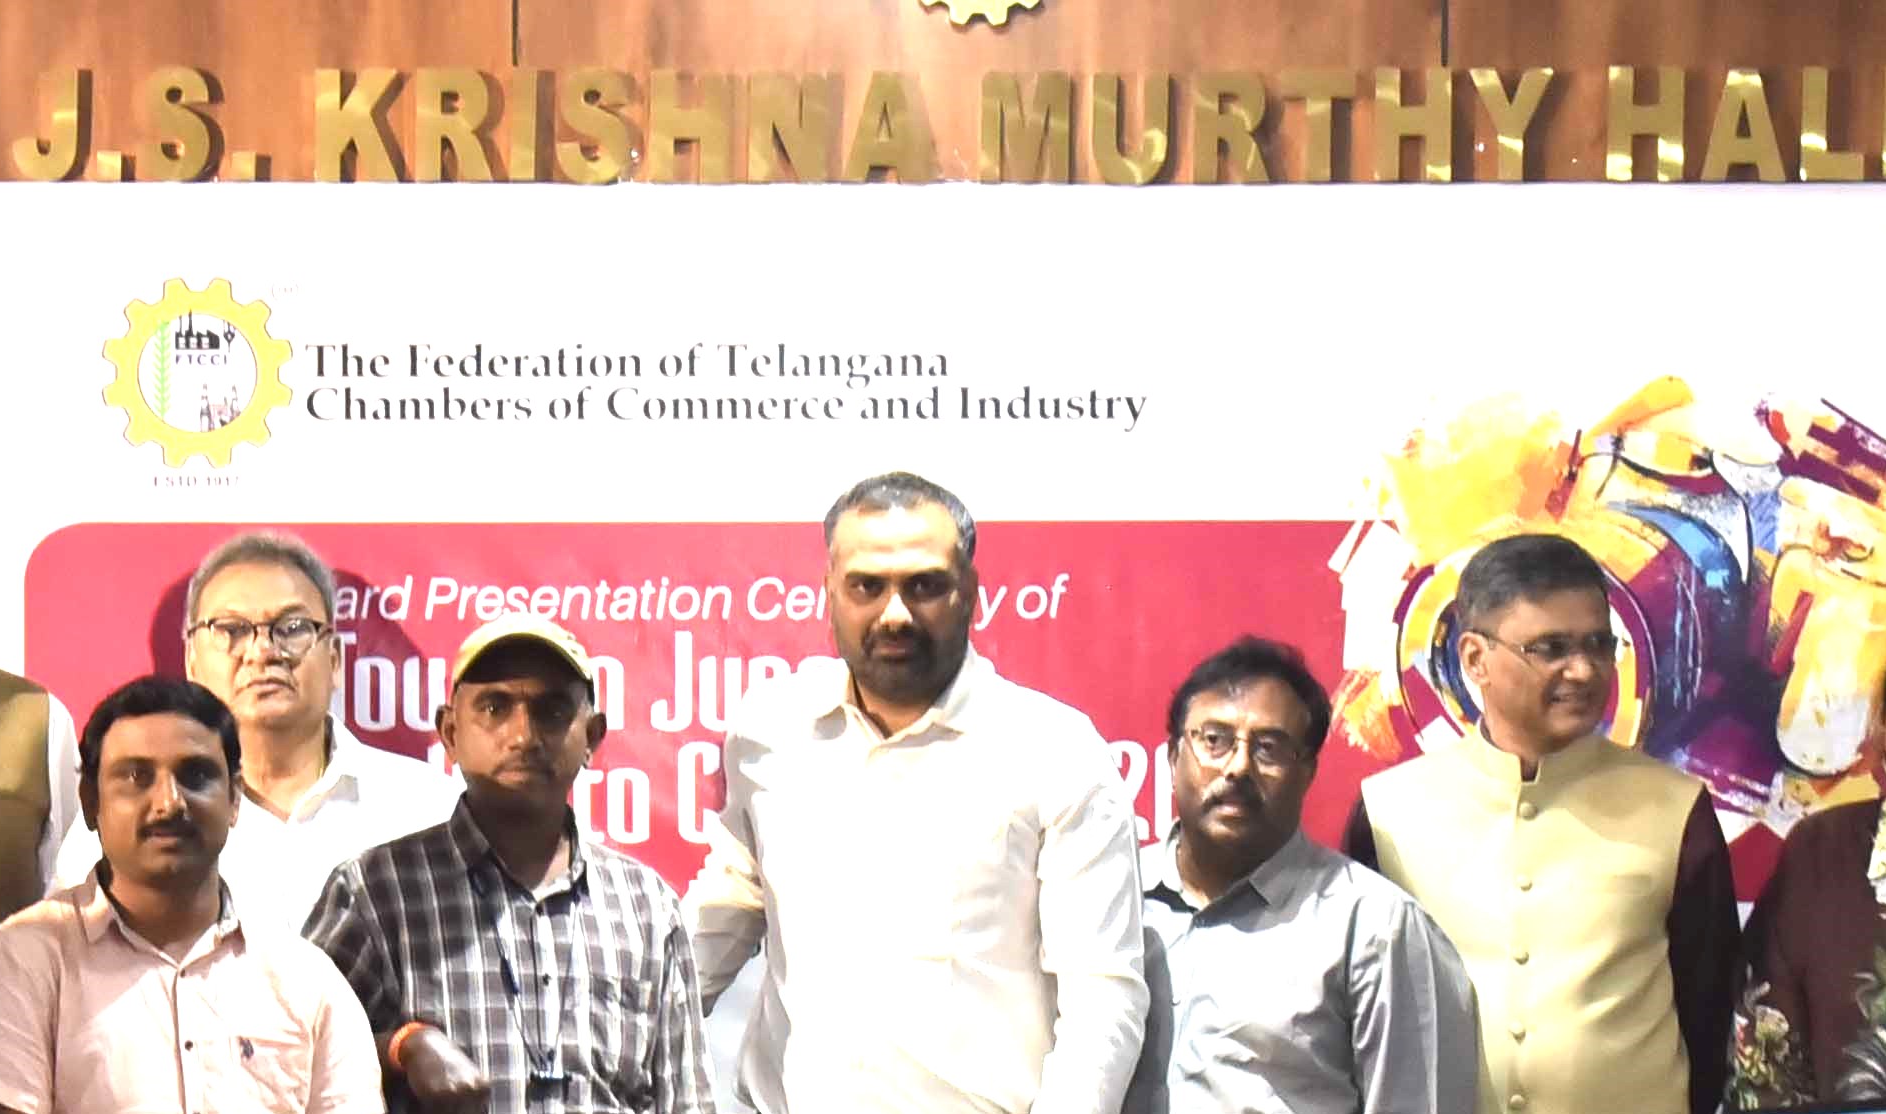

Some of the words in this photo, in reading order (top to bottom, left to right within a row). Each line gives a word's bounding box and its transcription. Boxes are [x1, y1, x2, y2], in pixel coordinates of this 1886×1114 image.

[11, 66, 271, 181] J.S.
[313, 67, 934, 184] KRISHNA
[979, 65, 1554, 184] MURTHY
[175, 354, 228, 365] FTCCI
[305, 343, 391, 377] The
[409, 343, 642, 377] Federation
[659, 342, 703, 377] of
[717, 343, 949, 387] Telangana
[306, 386, 533, 420] Chambers
[548, 386, 593, 420] of
[607, 387, 847, 420] Commerce
[860, 386, 941, 420] and
[960, 386, 1147, 432] Industry
[334, 575, 414, 621] ard
[424, 575, 731, 621] Presentation
[1016, 573, 1070, 620] of
